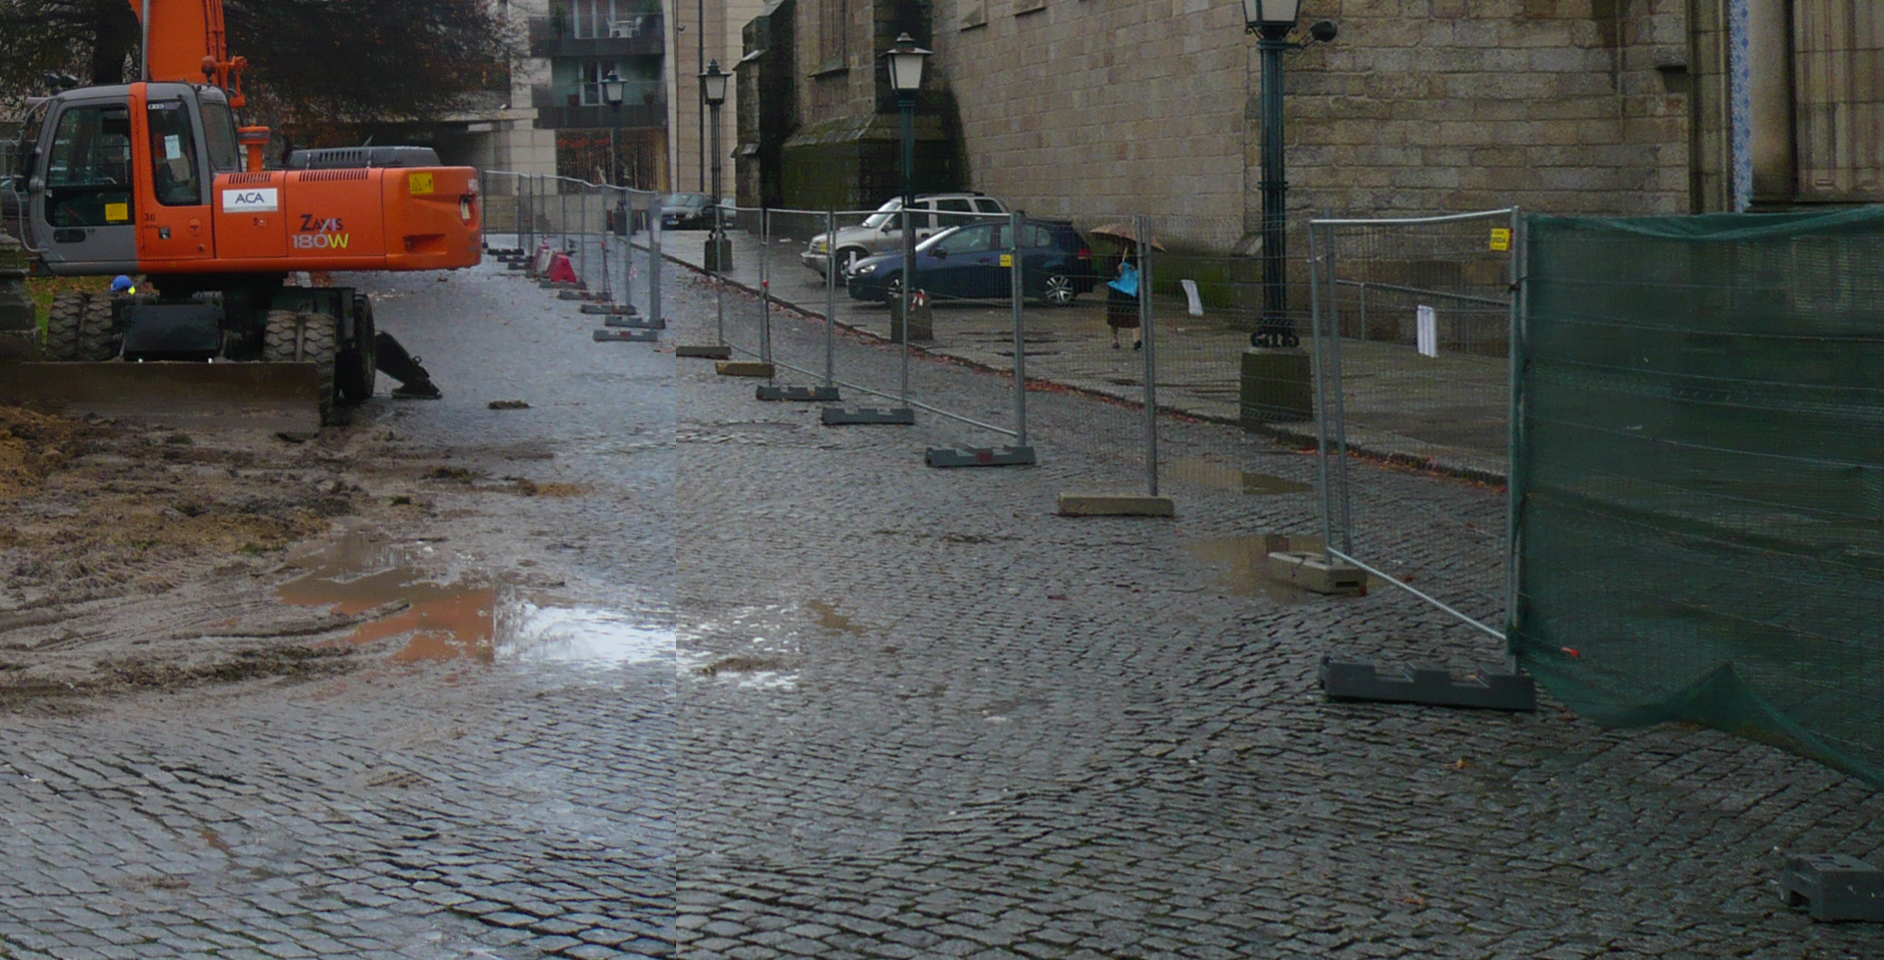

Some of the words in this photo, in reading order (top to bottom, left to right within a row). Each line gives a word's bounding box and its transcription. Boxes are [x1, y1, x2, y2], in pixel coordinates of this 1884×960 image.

[235, 193, 265, 204] ACA
[300, 213, 344, 233] ZAXIS
[291, 233, 350, 249] 180W
